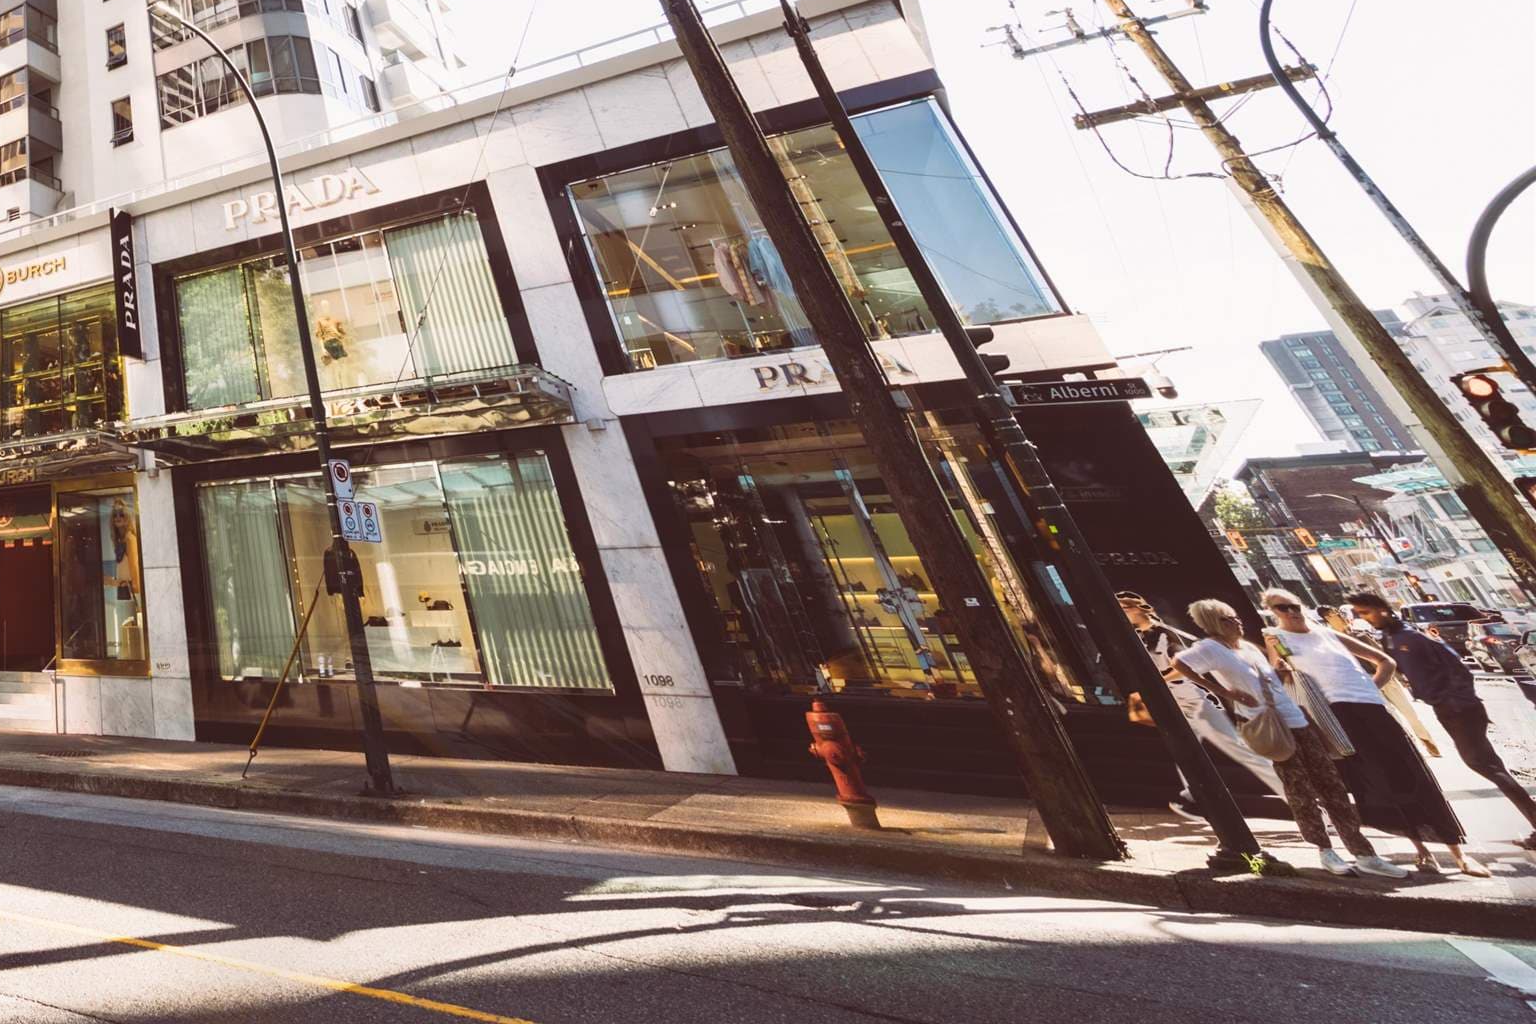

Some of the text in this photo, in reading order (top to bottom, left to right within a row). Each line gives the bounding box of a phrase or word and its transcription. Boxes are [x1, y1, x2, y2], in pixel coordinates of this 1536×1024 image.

[222, 165, 383, 232] PRADA
[6, 255, 67, 285] BURCH
[120, 234, 138, 331] PRADA
[1050, 383, 1120, 400] Alberni
[643, 674, 674, 687] 1098
